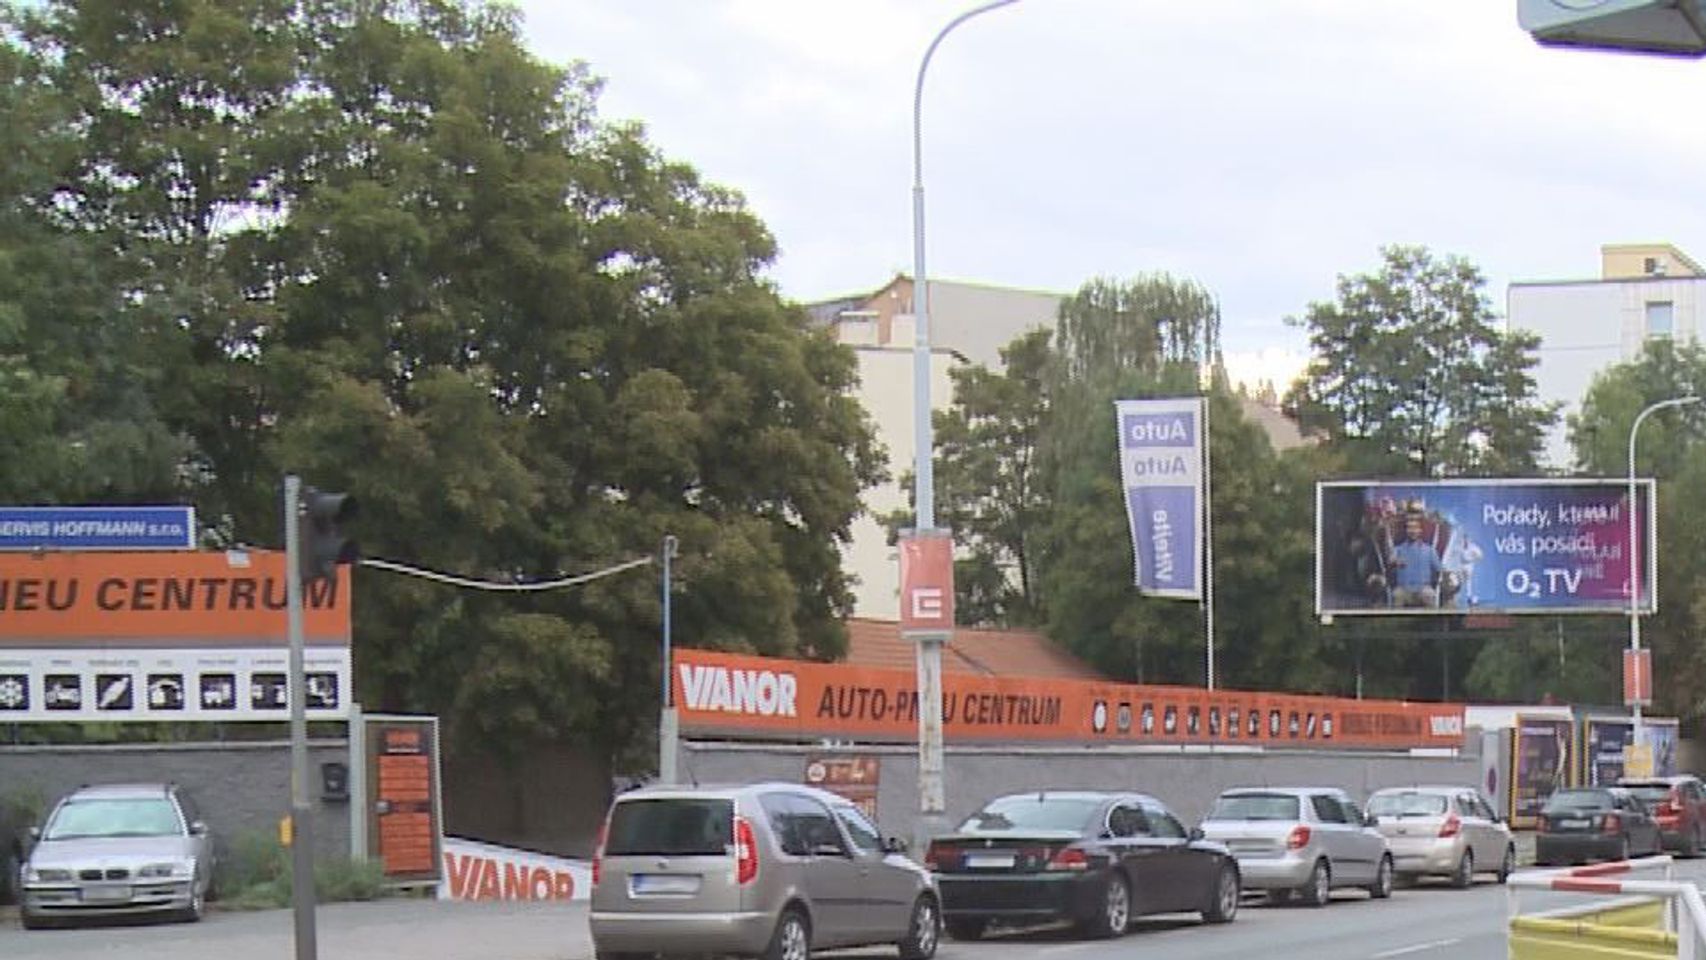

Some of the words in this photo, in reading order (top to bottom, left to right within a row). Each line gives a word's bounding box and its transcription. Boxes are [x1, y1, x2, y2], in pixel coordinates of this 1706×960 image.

[0, 519, 50, 537] ERVIS
[53, 519, 145, 538] HOFFMANN
[0, 577, 78, 611] EU
[95, 576, 338, 612] CENTRUM
[1543, 568, 1582, 594] TV
[679, 663, 798, 718] VIANOR
[962, 690, 1062, 726] CENTRUM
